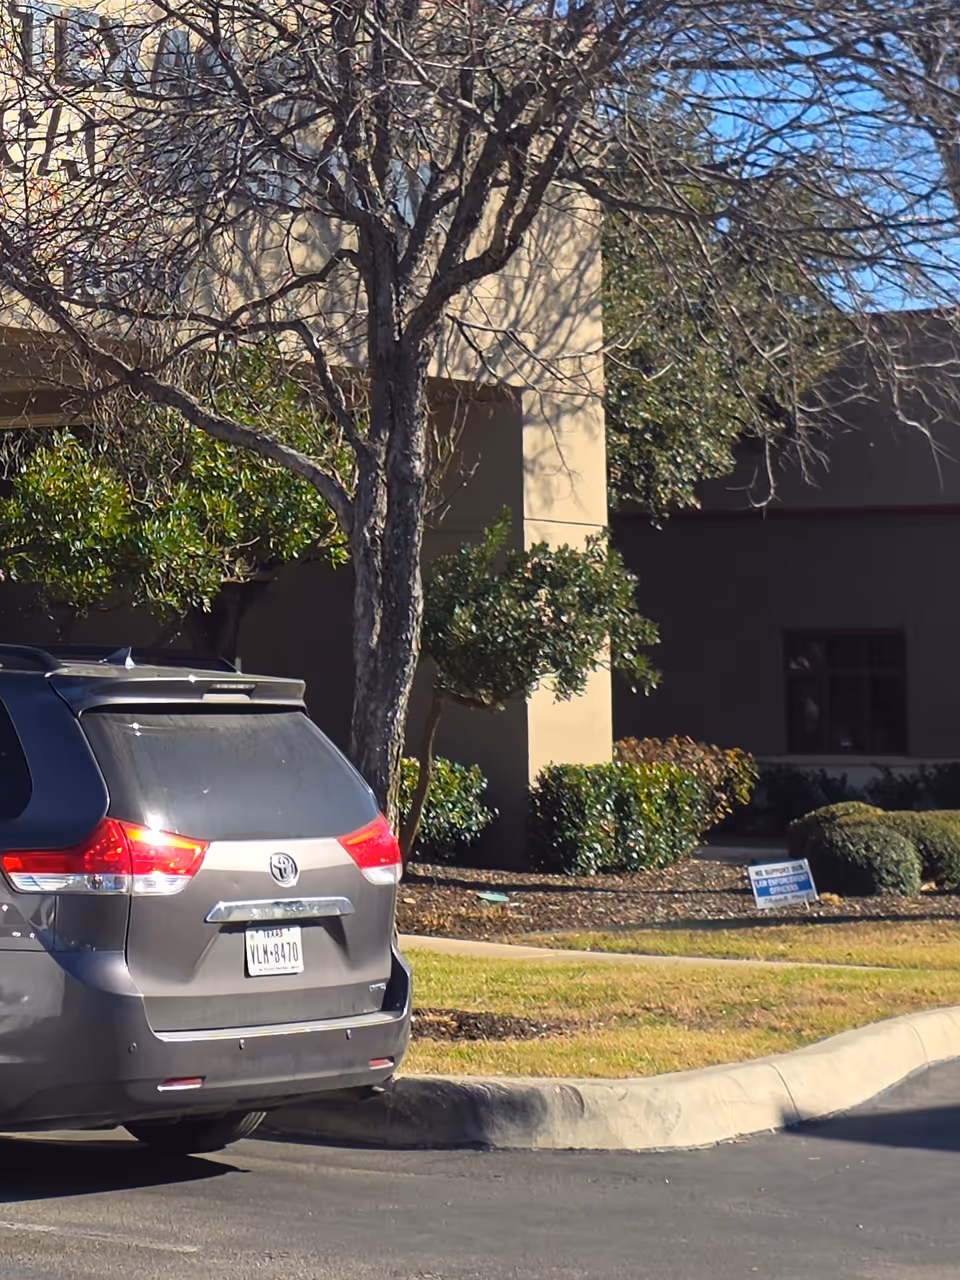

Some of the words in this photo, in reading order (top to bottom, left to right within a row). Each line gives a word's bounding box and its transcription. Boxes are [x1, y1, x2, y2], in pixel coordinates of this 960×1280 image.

[764, 866, 790, 876] SUPPORT
[767, 874, 809, 886] ENFORCEMENT
[769, 883, 800, 895] OFFICERS
[263, 929, 283, 939] TEXAS
